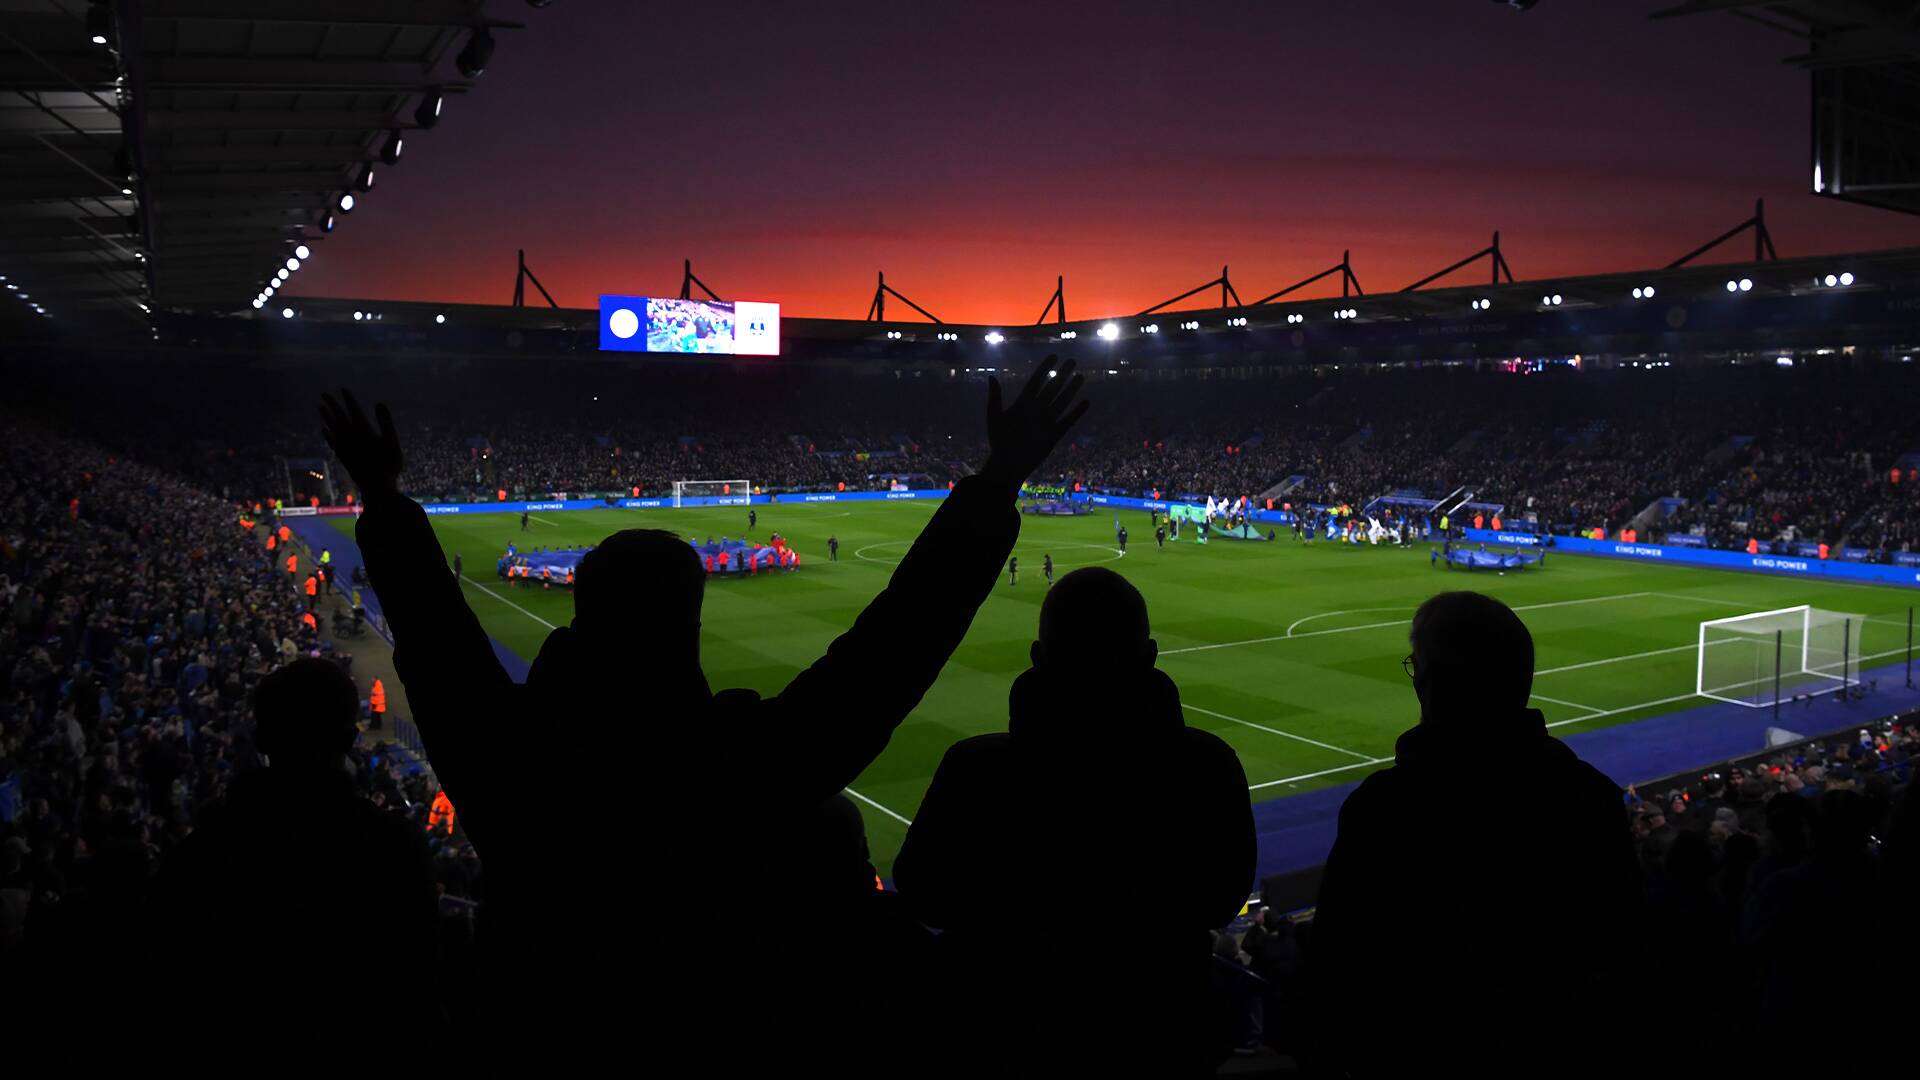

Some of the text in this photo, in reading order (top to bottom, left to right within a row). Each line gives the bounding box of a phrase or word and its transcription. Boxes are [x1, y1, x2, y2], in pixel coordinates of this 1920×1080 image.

[1497, 535, 1515, 543] KING
[1615, 545, 1662, 557] KING POWER
[1752, 558, 1808, 570] KING POWER
